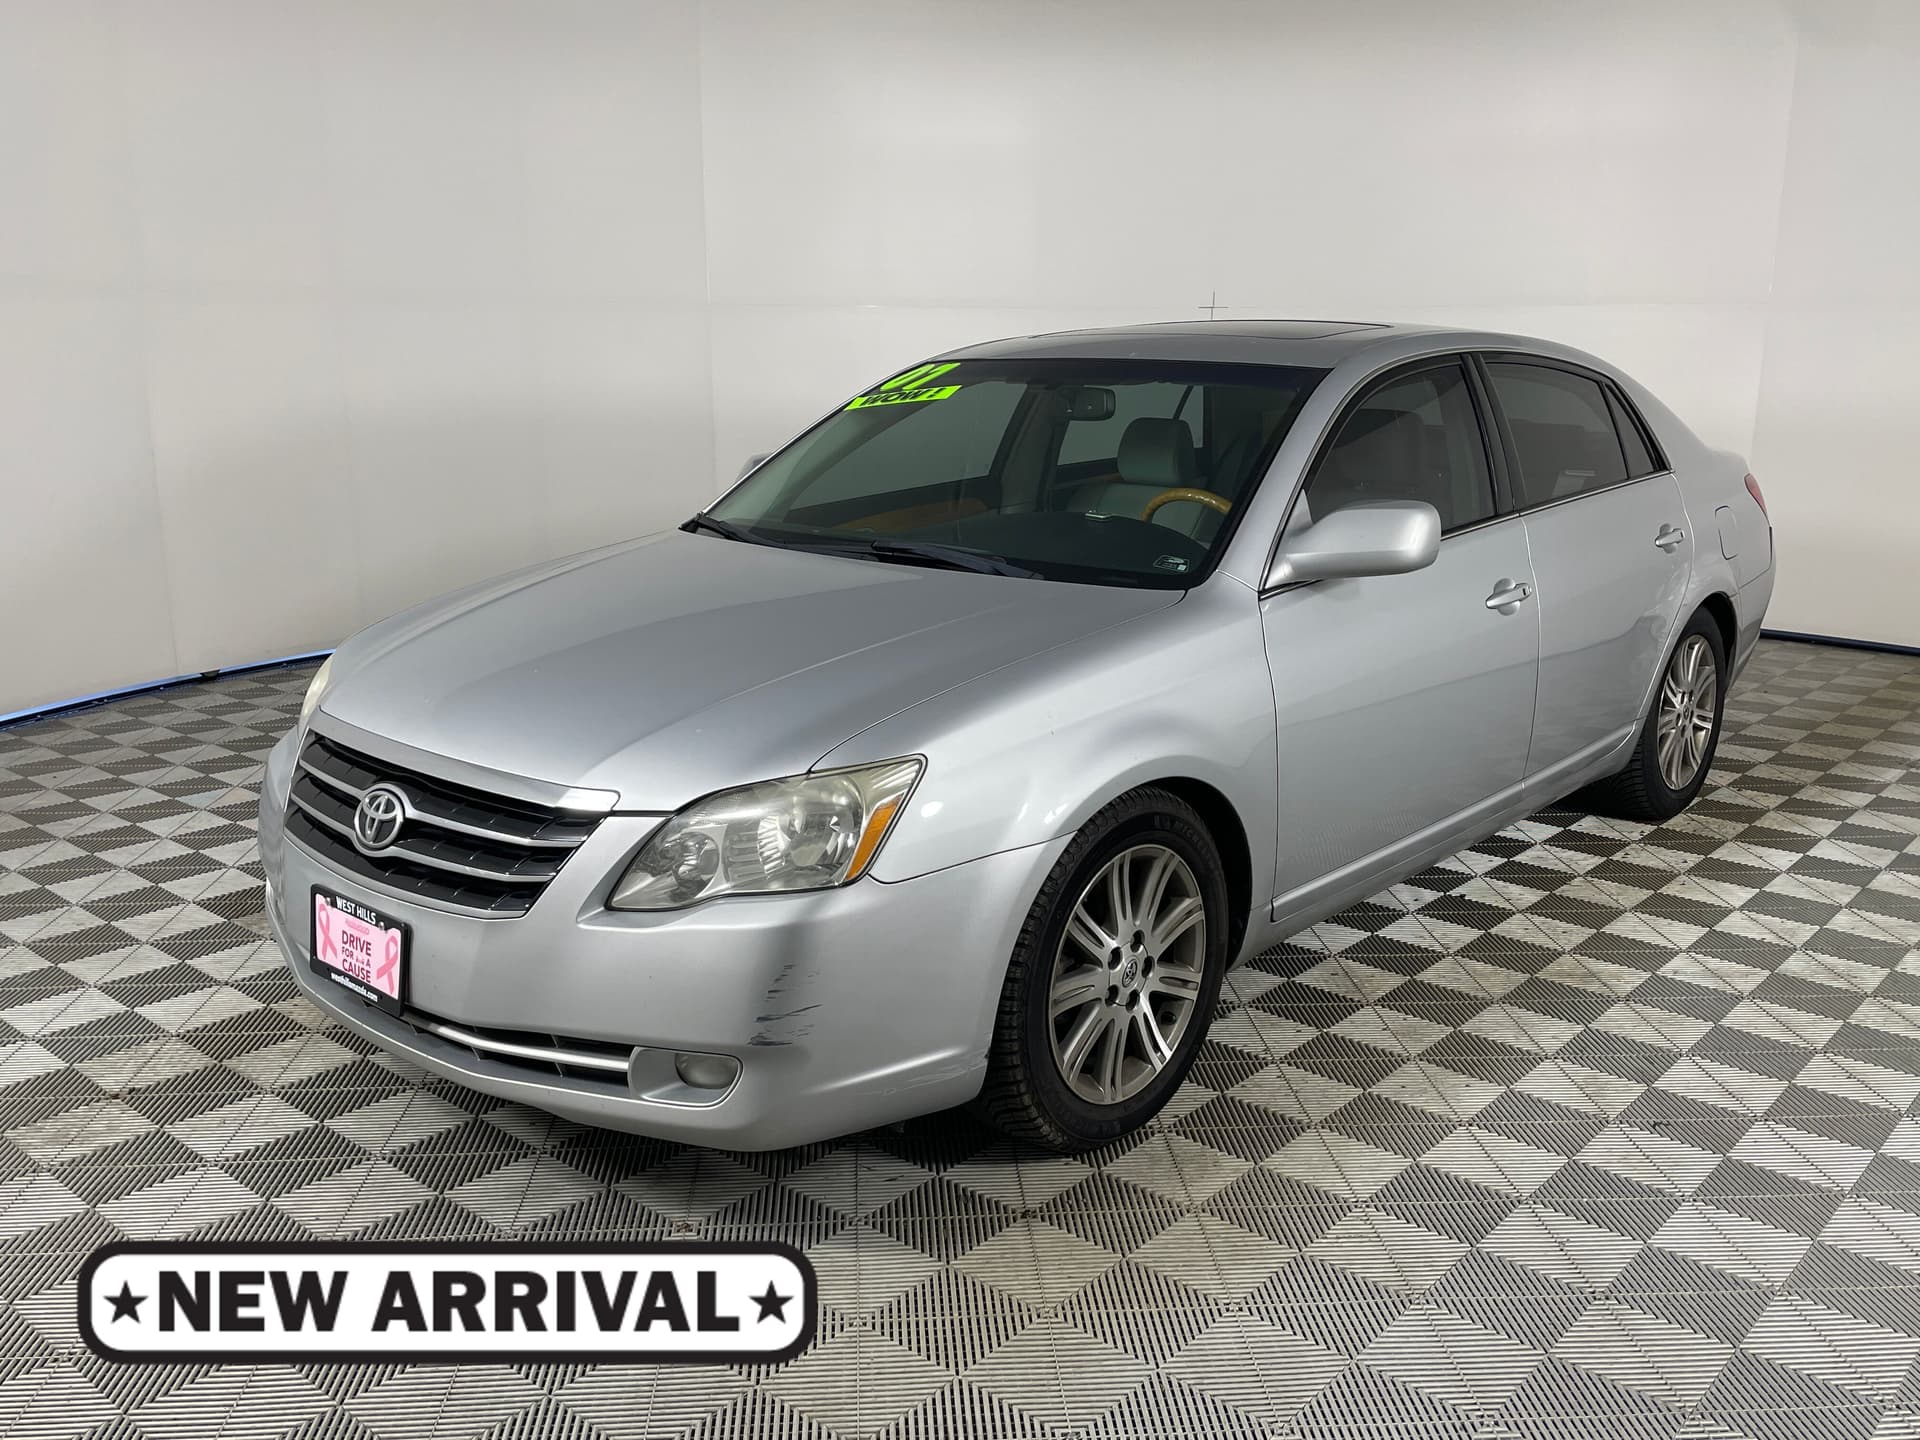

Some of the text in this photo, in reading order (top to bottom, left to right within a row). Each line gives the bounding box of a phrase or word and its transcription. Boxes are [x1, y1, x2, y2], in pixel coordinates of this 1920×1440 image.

[880, 362, 961, 391] 07
[336, 896, 377, 925] WEST HILLS
[341, 930, 372, 957] DRIVE
[341, 946, 354, 959] FOR
[366, 959, 371, 969] A
[342, 959, 371, 984] CAUSE
